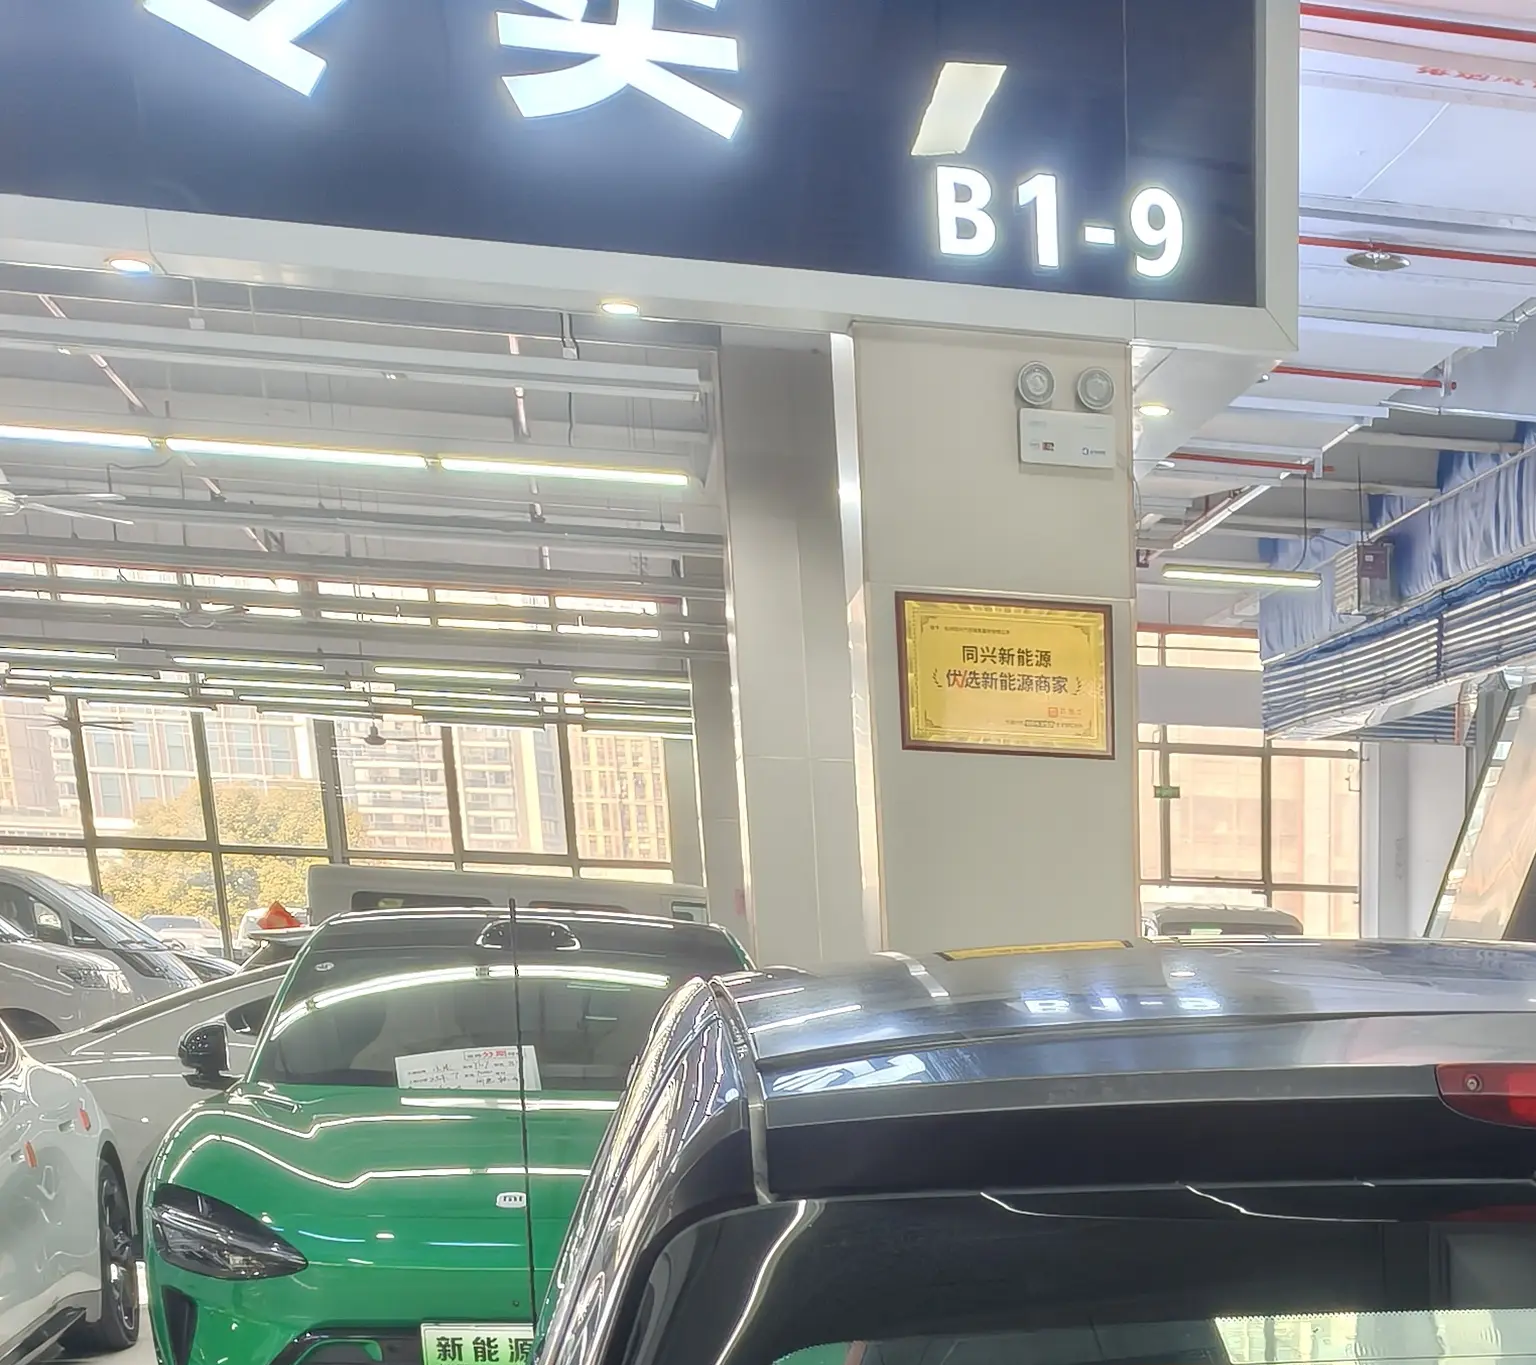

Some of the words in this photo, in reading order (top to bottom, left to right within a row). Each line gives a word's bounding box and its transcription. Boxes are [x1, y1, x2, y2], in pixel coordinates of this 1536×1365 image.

[934, 164, 1188, 280] B1-9
[962, 645, 1052, 668] 同兴新能源
